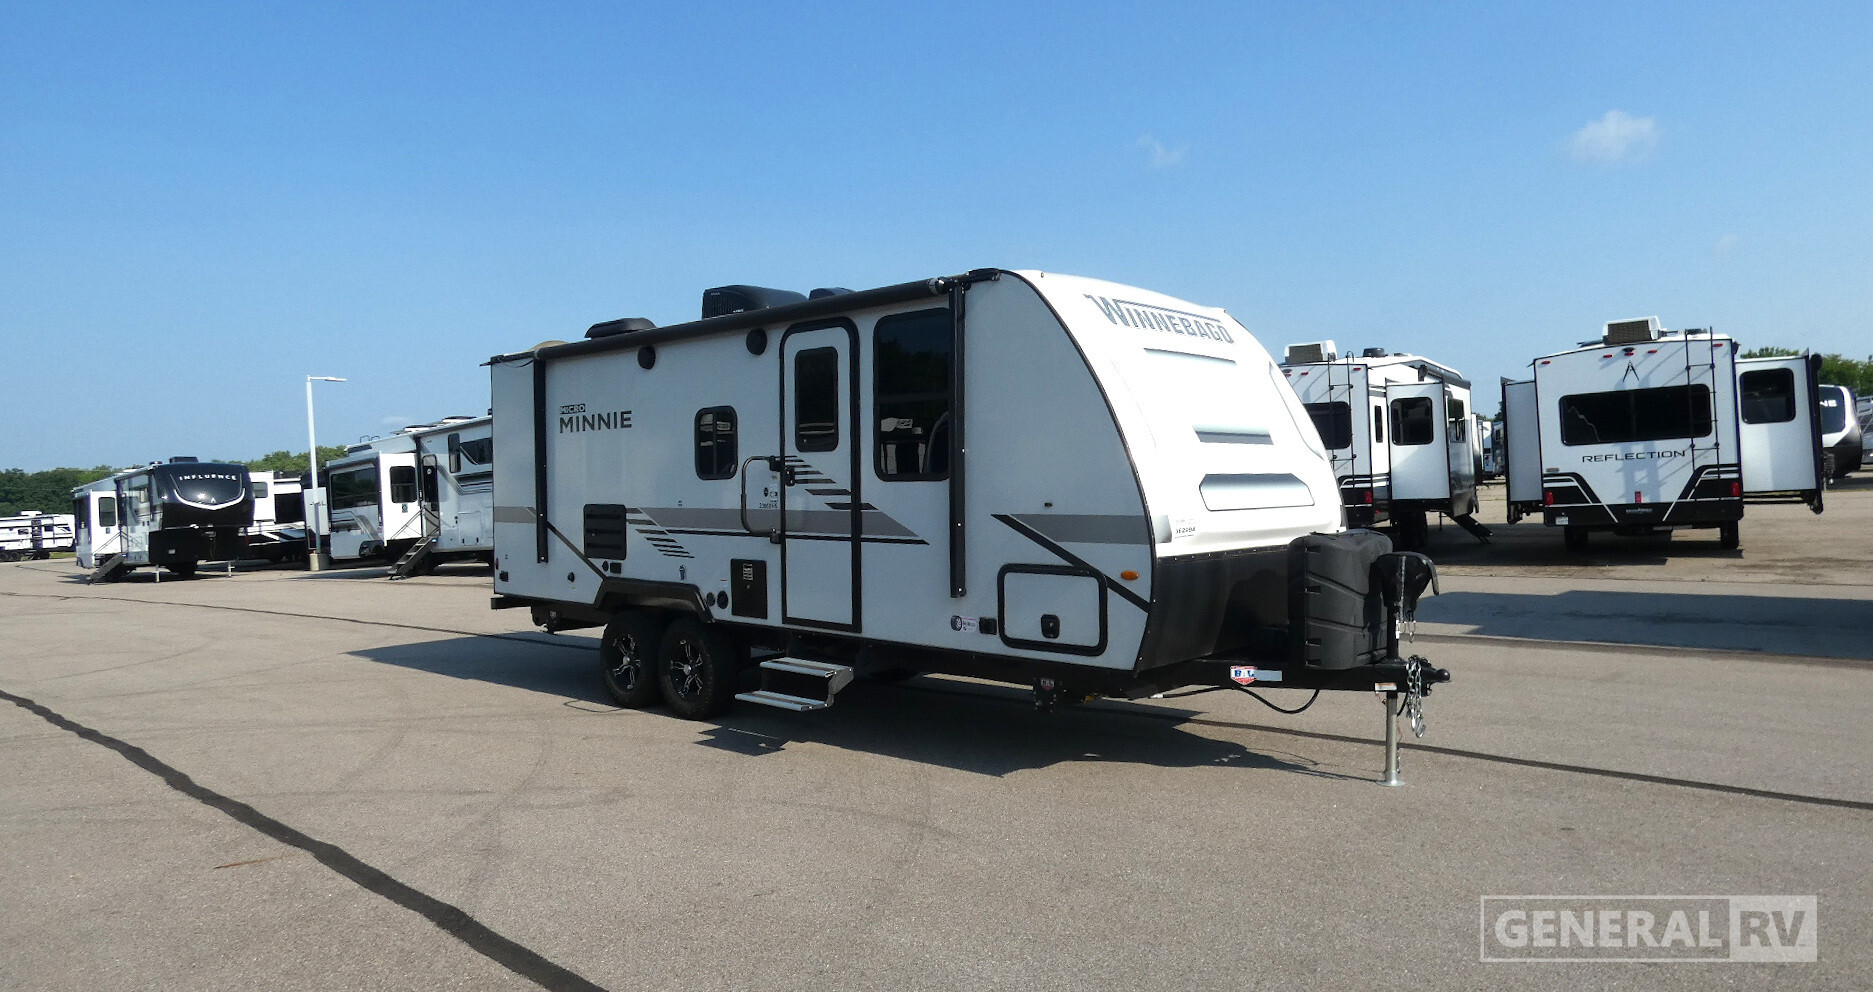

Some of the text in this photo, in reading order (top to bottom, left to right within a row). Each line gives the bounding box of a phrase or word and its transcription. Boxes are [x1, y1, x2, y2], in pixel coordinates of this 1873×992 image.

[1082, 294, 1234, 344] WINNEBAGO
[560, 404, 586, 414] MICRO
[559, 411, 632, 433] MINNIE
[1582, 450, 1686, 463] REFLECTION
